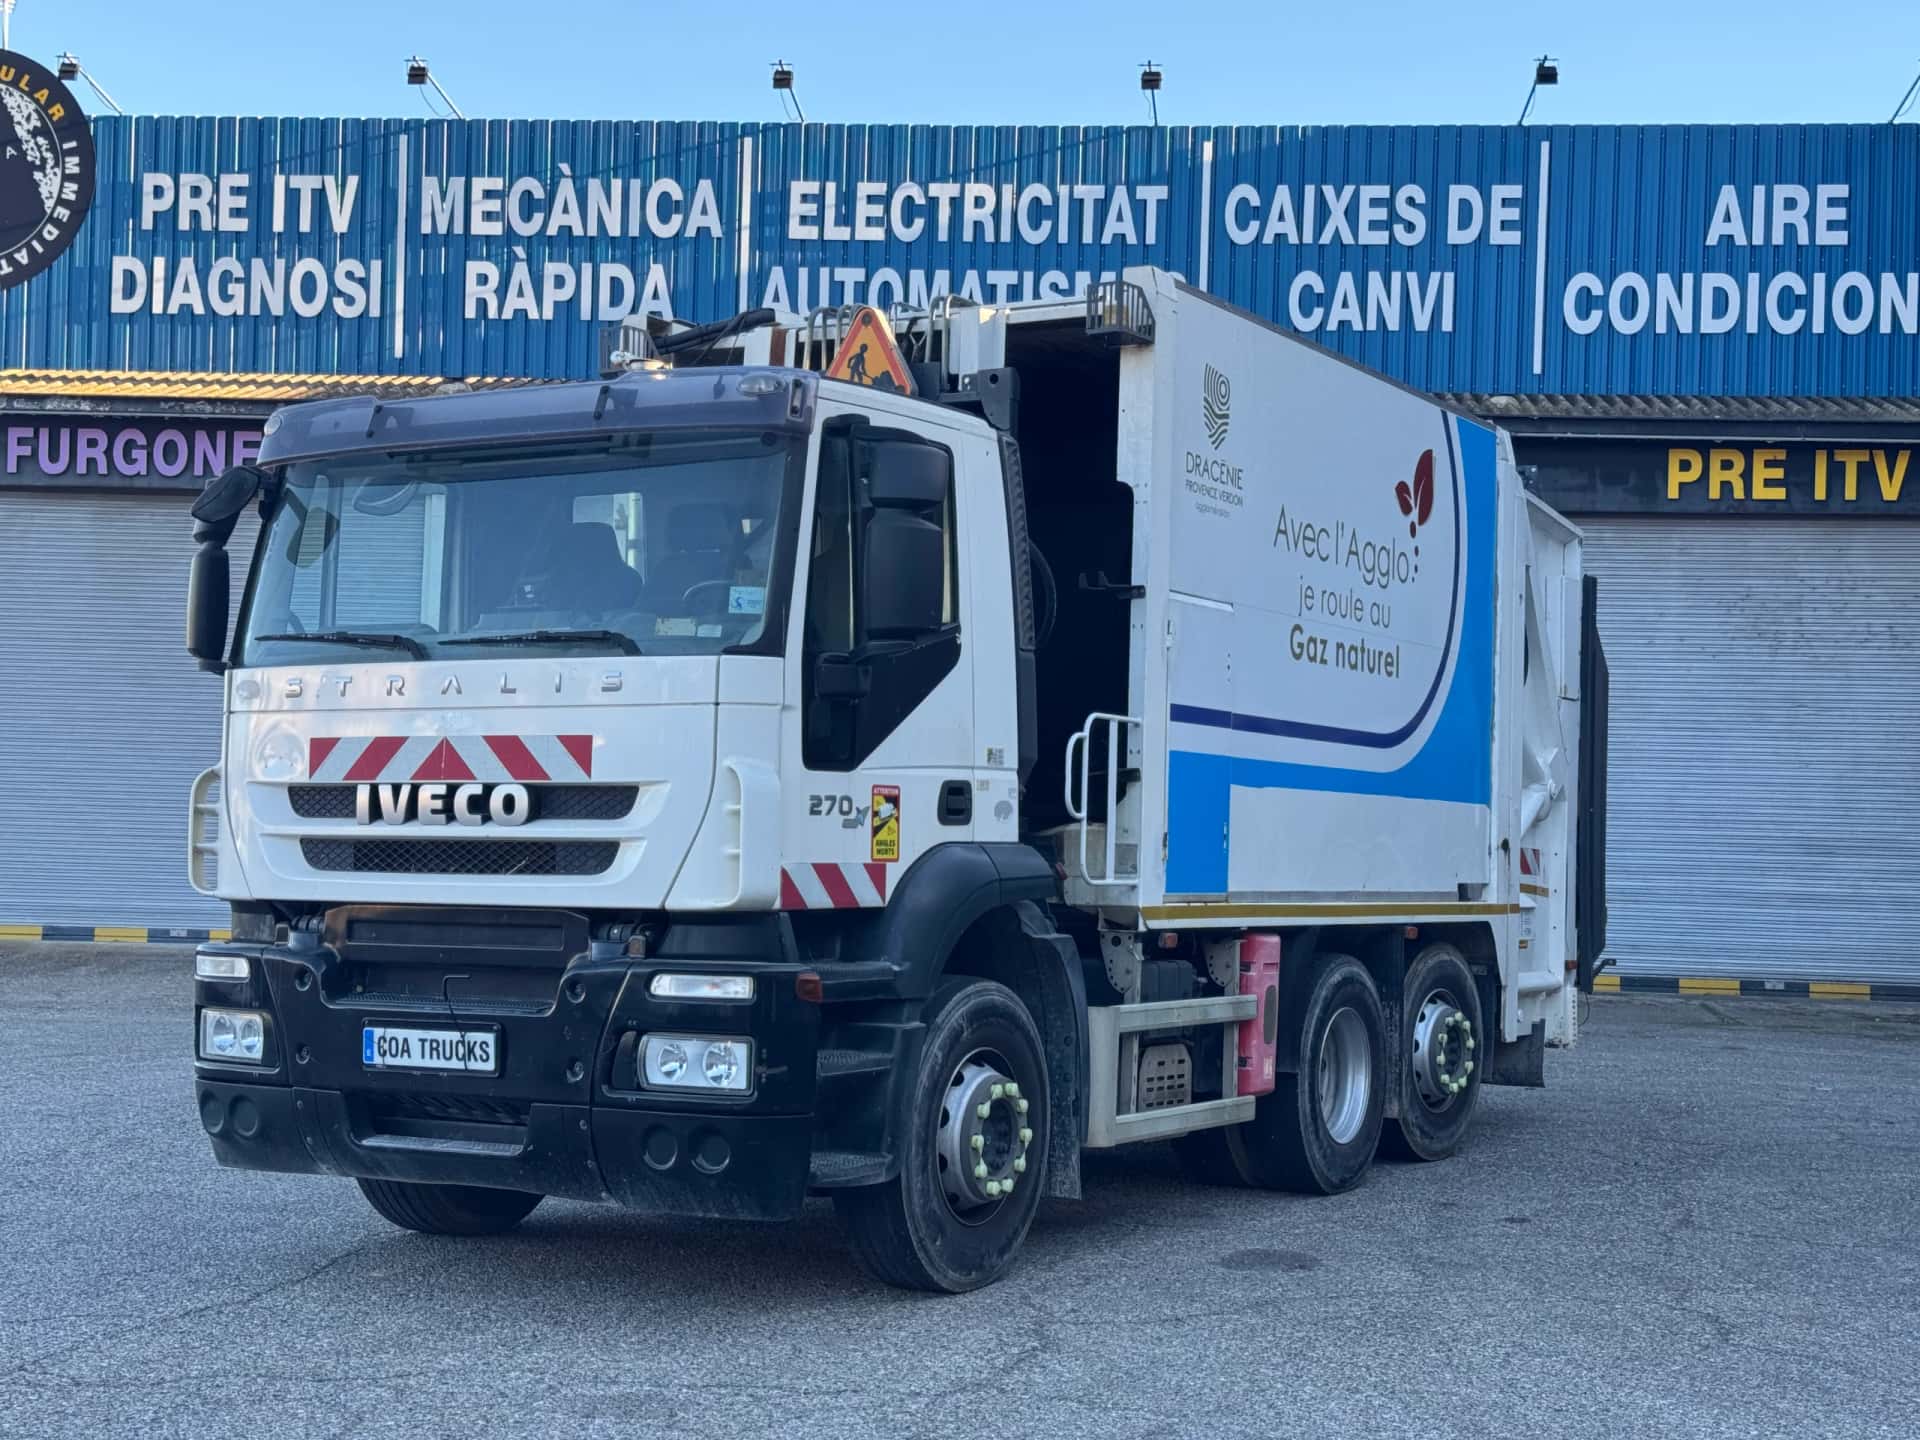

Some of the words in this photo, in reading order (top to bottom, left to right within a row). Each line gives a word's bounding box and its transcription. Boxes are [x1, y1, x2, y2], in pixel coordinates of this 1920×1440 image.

[141, 172, 249, 232] PRE
[272, 174, 359, 233] ITV
[420, 163, 722, 238] MECÀNICA
[788, 180, 1169, 245] ELECTRICITAT
[1225, 183, 1427, 246] CAIXES
[1447, 185, 1523, 245] DE
[1706, 184, 1849, 246] AIRE
[110, 255, 381, 318] DIAGNOSI
[464, 246, 674, 321] RÀPIDA
[1288, 270, 1454, 332] CANVI
[1563, 271, 1919, 335] CONDICION
[1667, 448, 1787, 500] PRE
[1814, 450, 1910, 501] ITV
[1273, 503, 1330, 562] Avec
[1298, 576, 1316, 616] je
[1320, 586, 1364, 620] roule
[1370, 602, 1391, 628] au
[1289, 623, 1329, 666] Gaz
[1335, 637, 1399, 679] naturel
[284, 670, 624, 697] STRALIS
[356, 783, 530, 826] IVECO
[808, 794, 853, 816] 270
[377, 1035, 412, 1060] COA
[418, 1037, 490, 1063] TRUCKS
